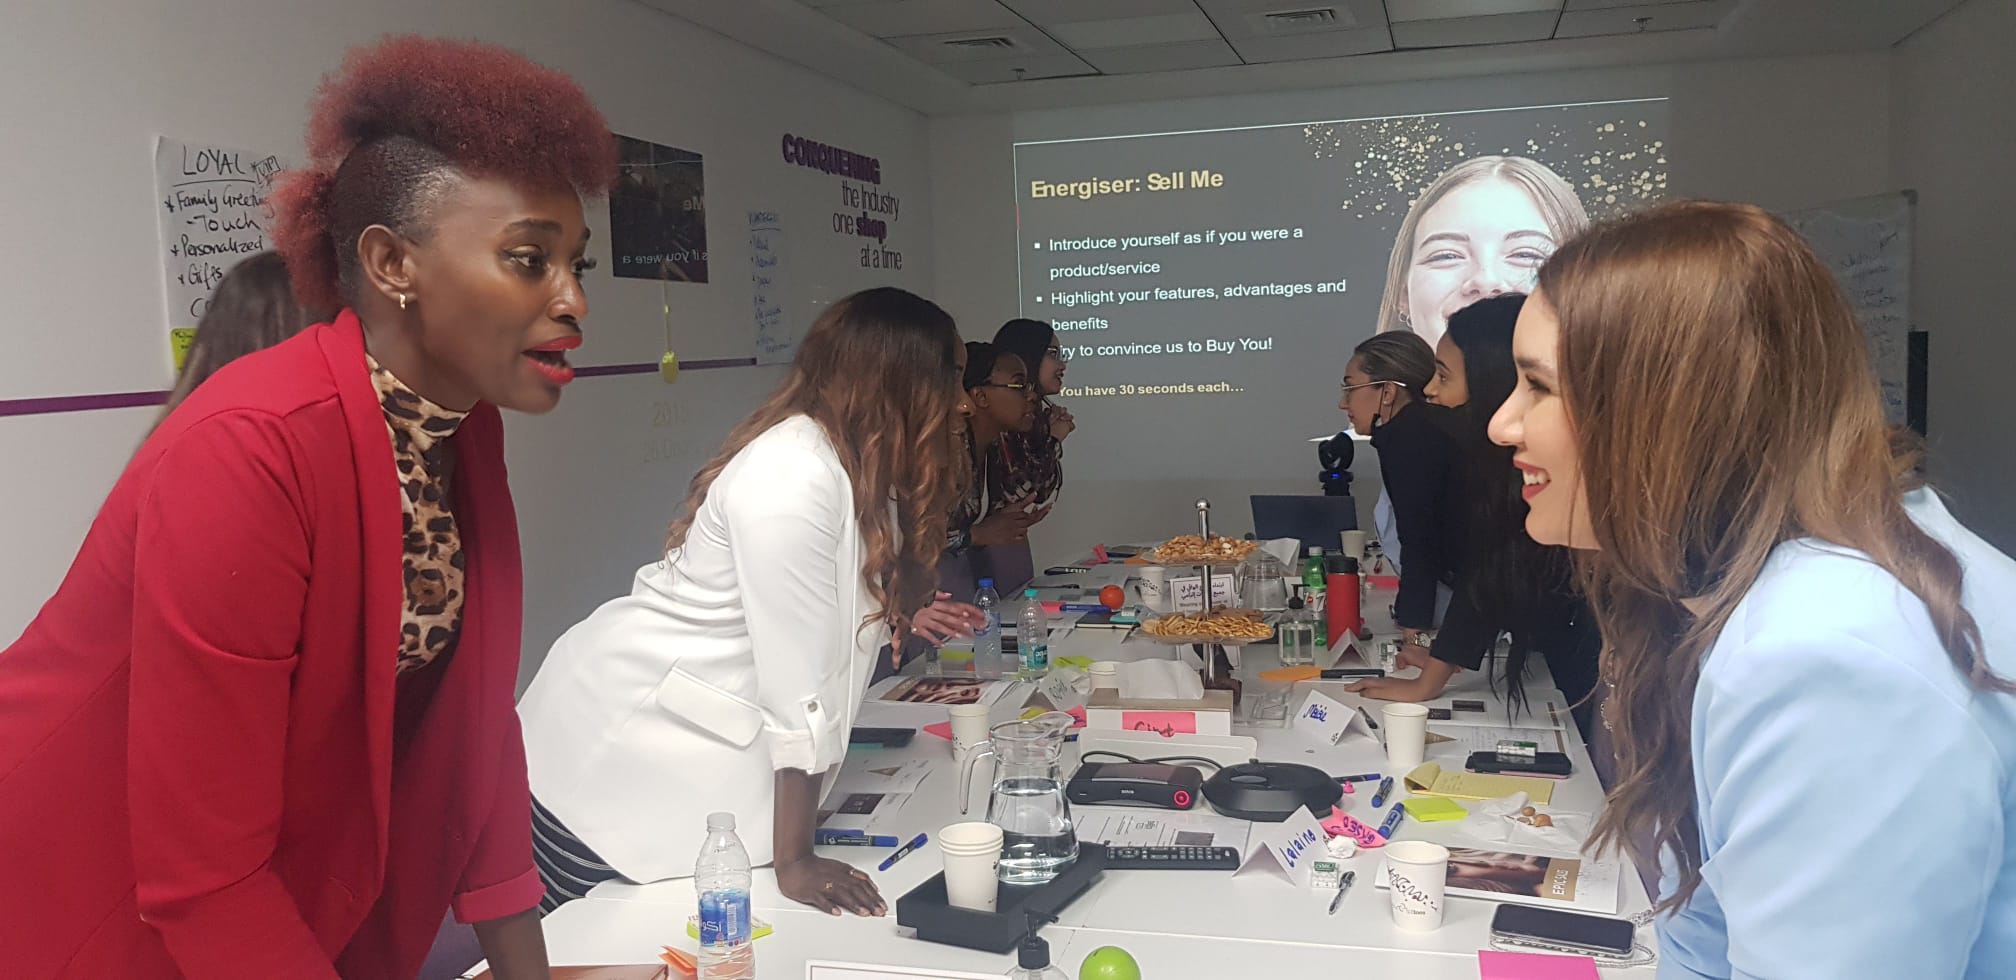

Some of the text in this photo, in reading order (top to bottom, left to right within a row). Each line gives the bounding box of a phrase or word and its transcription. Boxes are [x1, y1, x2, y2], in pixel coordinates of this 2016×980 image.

[182, 145, 246, 176] LOYAL
[782, 132, 882, 185] CONQUERING
[1031, 170, 1224, 200] Energiser: Sell Me
[176, 188, 219, 213] Family
[842, 179, 900, 222] the Industry
[832, 210, 888, 245] one shop
[1049, 227, 1304, 253] Introduce yourself as if you were a
[180, 233, 264, 259] Personalized
[861, 243, 903, 271] at a time
[1050, 261, 1161, 281] product/service
[1051, 279, 1347, 307] Highlight your features, advantages and
[1052, 316, 1109, 332] benefits
[1079, 343, 1094, 357] to
[1097, 340, 1162, 356] convince
[1166, 340, 1184, 354] us
[1188, 338, 1202, 353] to
[1206, 339, 1236, 355] Buy
[1239, 336, 1273, 351] You!
[1059, 385, 1083, 398] You
[1085, 384, 1117, 396] have
[1119, 383, 1135, 395] 30
[1137, 381, 1195, 395] seconds
